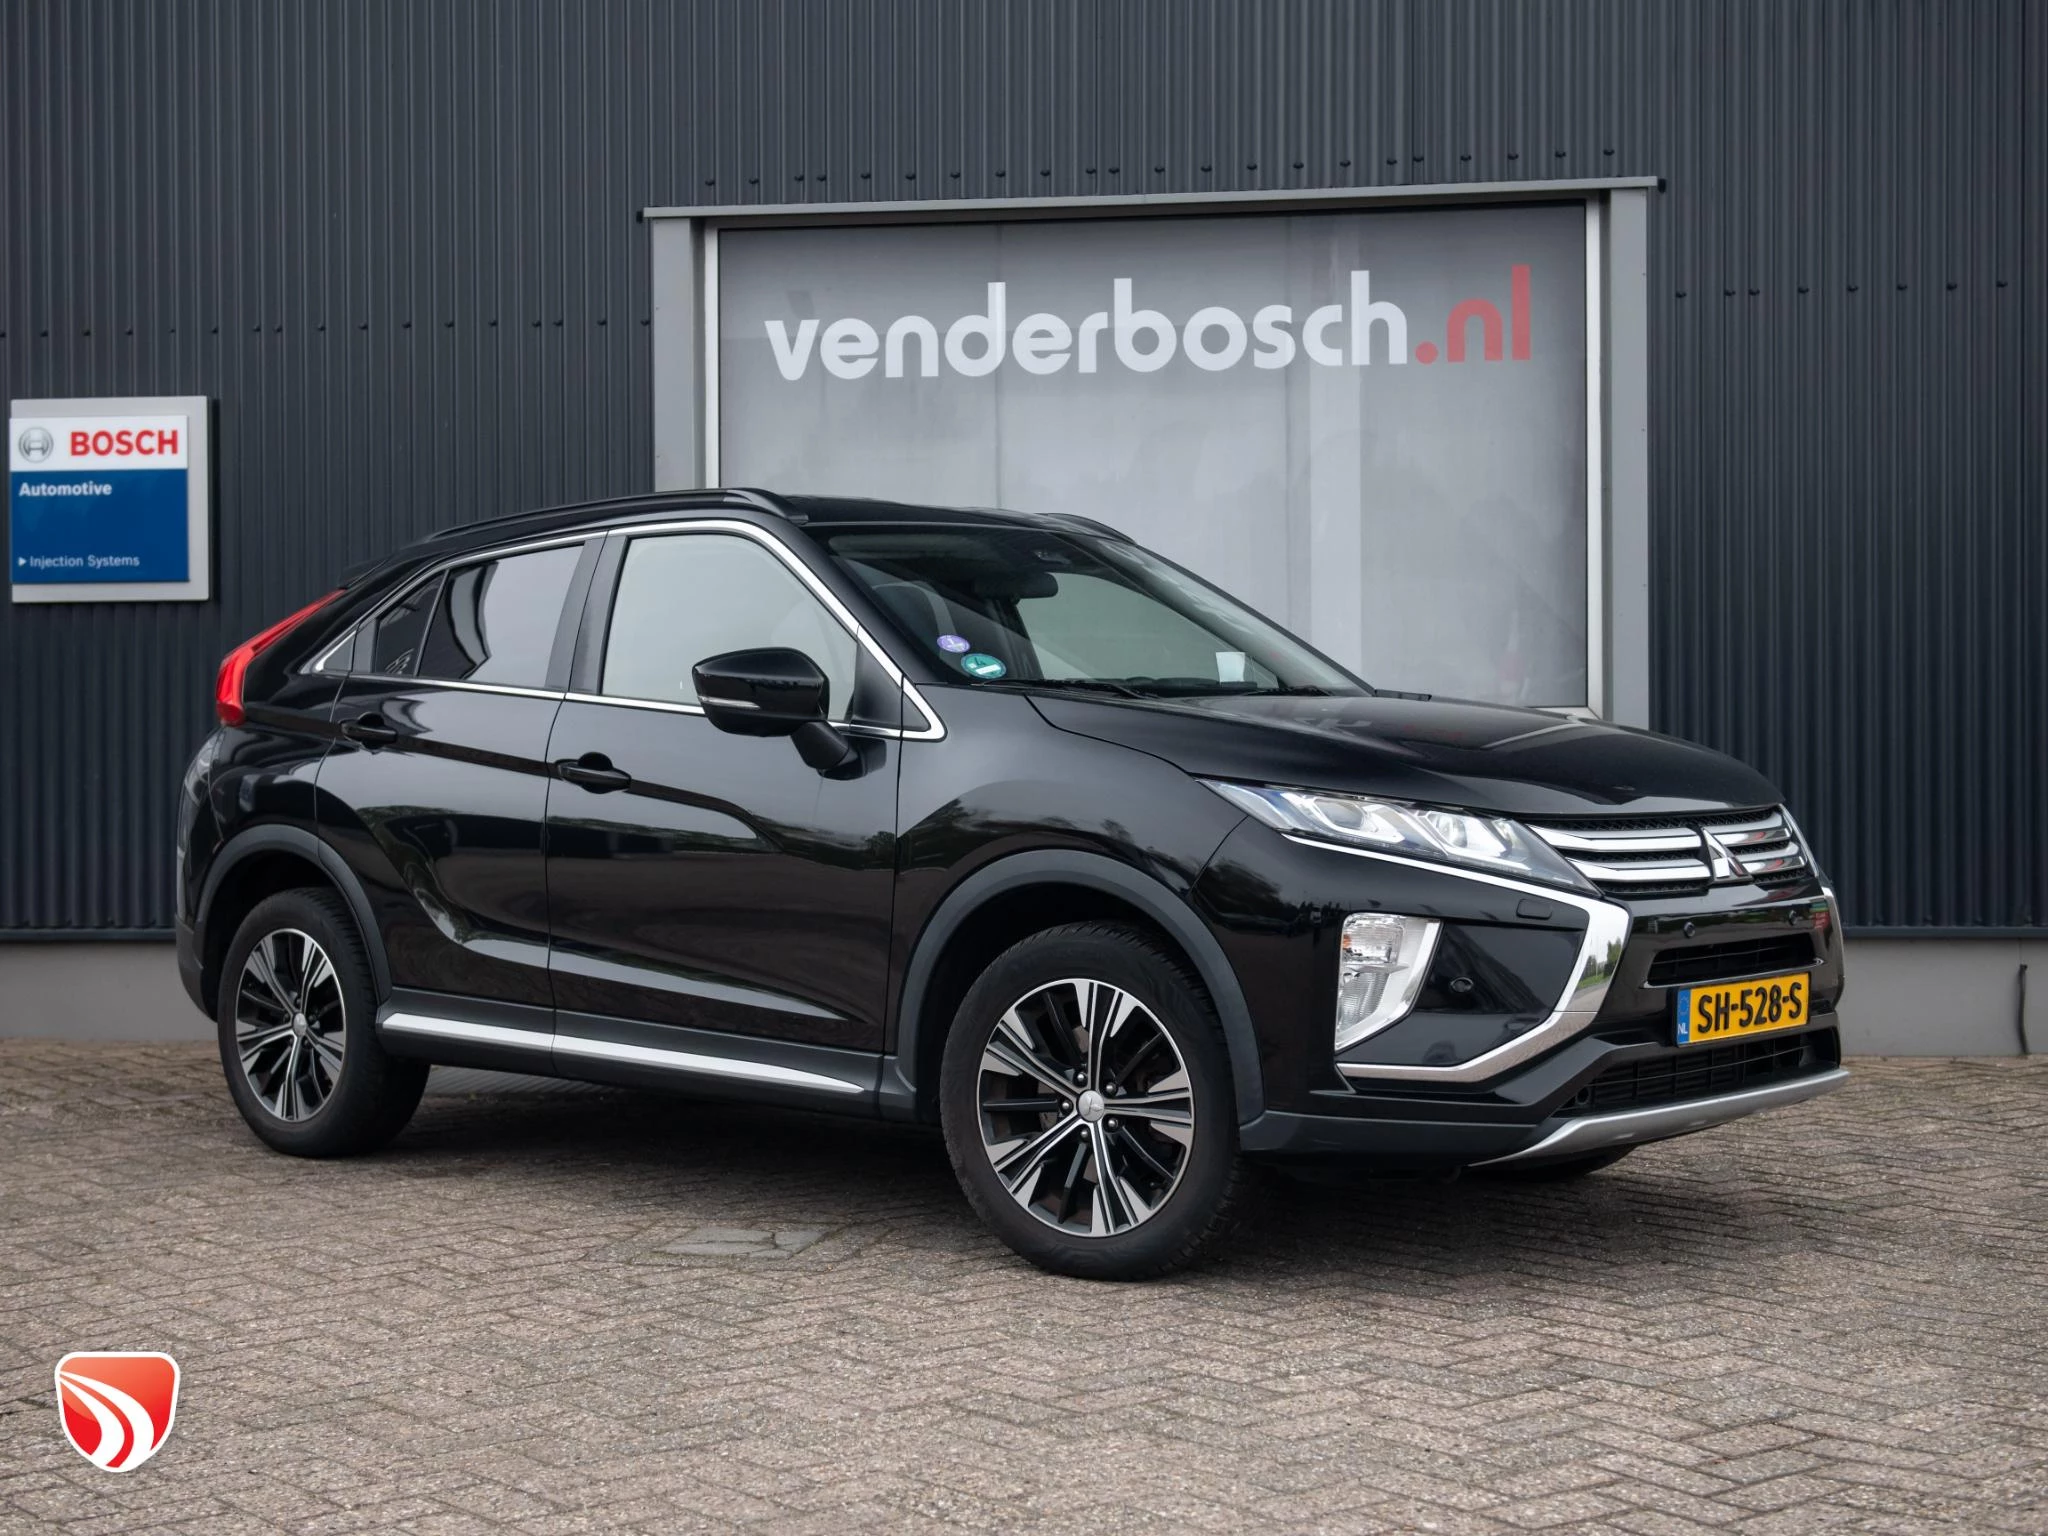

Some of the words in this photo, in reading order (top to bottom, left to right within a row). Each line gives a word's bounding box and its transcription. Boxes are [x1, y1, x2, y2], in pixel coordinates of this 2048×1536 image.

[765, 265, 1531, 381] venderbosch.nl
[70, 430, 178, 456] BOSCH
[19, 481, 112, 496] Automotive
[29, 556, 84, 569] Injection
[87, 555, 140, 568] Systems
[1697, 982, 1802, 1034] SH-528-S
[1677, 1024, 1688, 1035] NL
